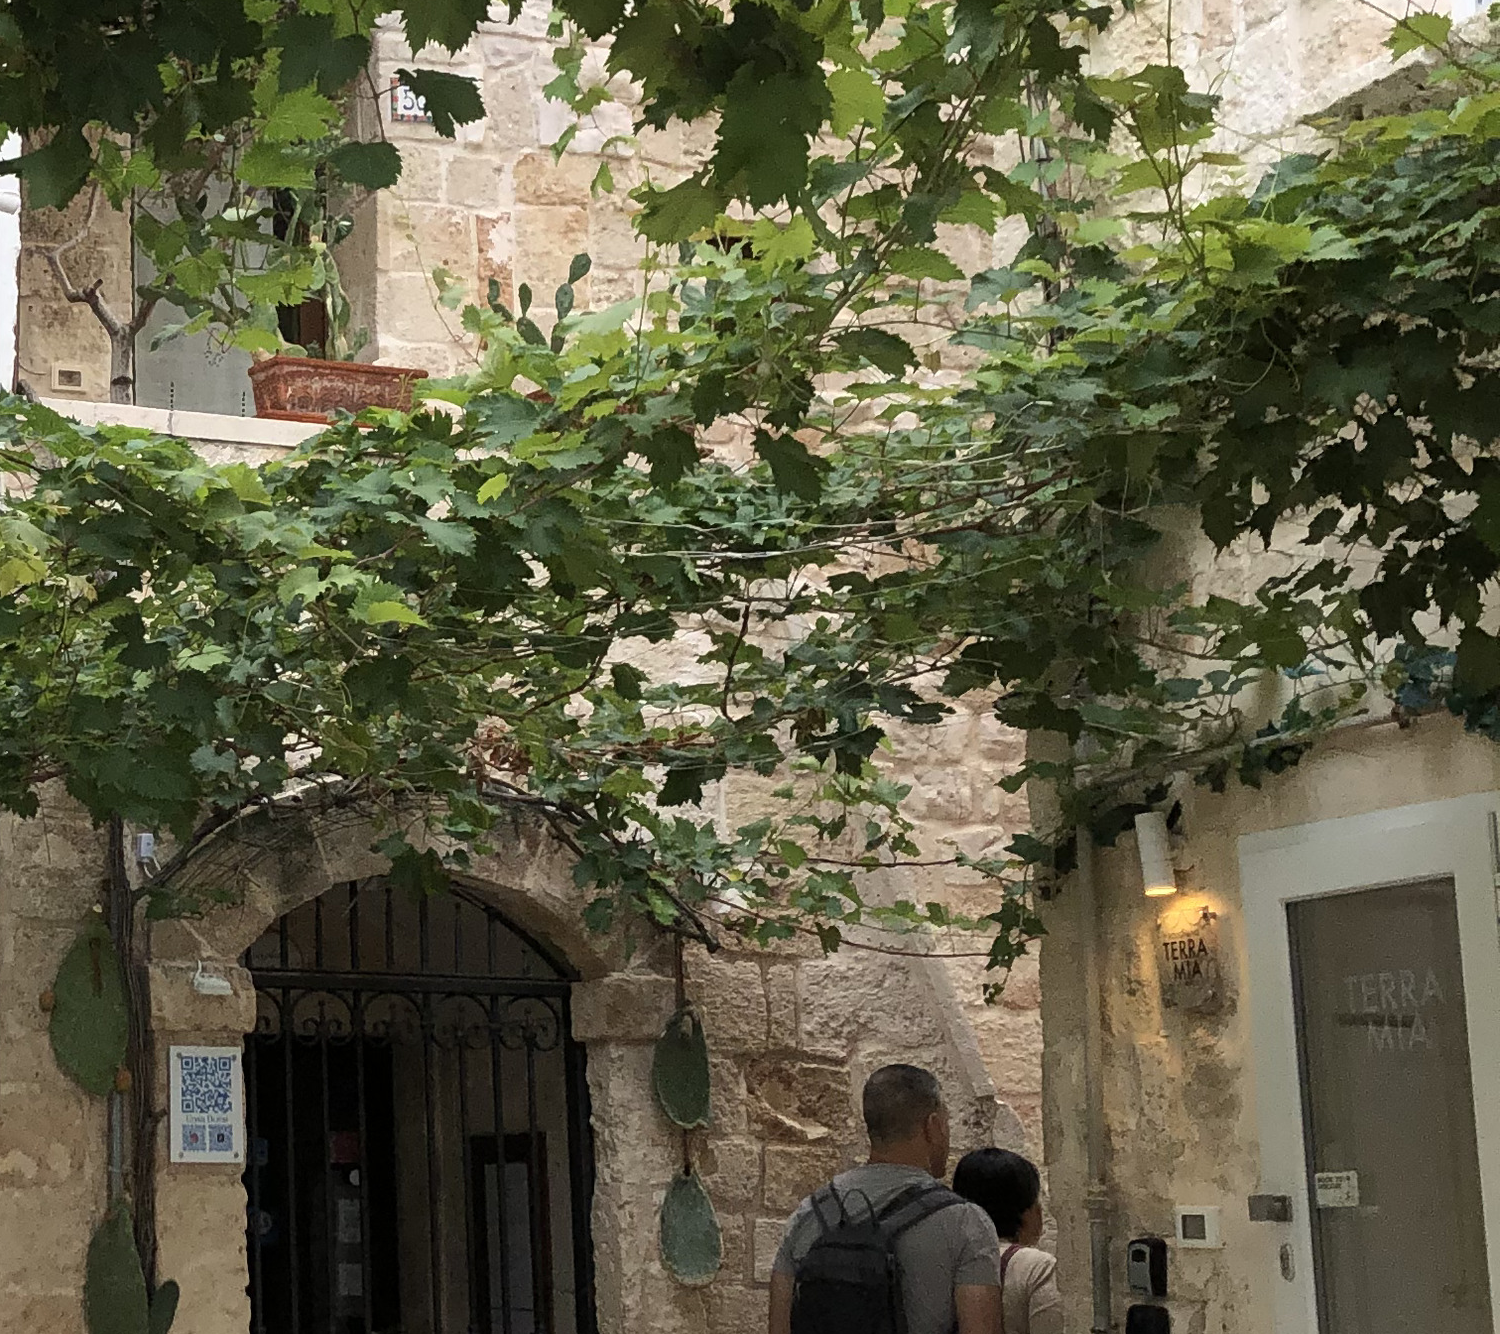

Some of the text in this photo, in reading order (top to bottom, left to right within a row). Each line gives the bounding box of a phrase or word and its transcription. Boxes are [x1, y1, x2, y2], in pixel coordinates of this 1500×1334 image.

[1162, 938, 1209, 962] TERRA
[1173, 960, 1204, 981] MIA
[1344, 968, 1446, 1015] TERRA
[1367, 1010, 1433, 1052] MIA
